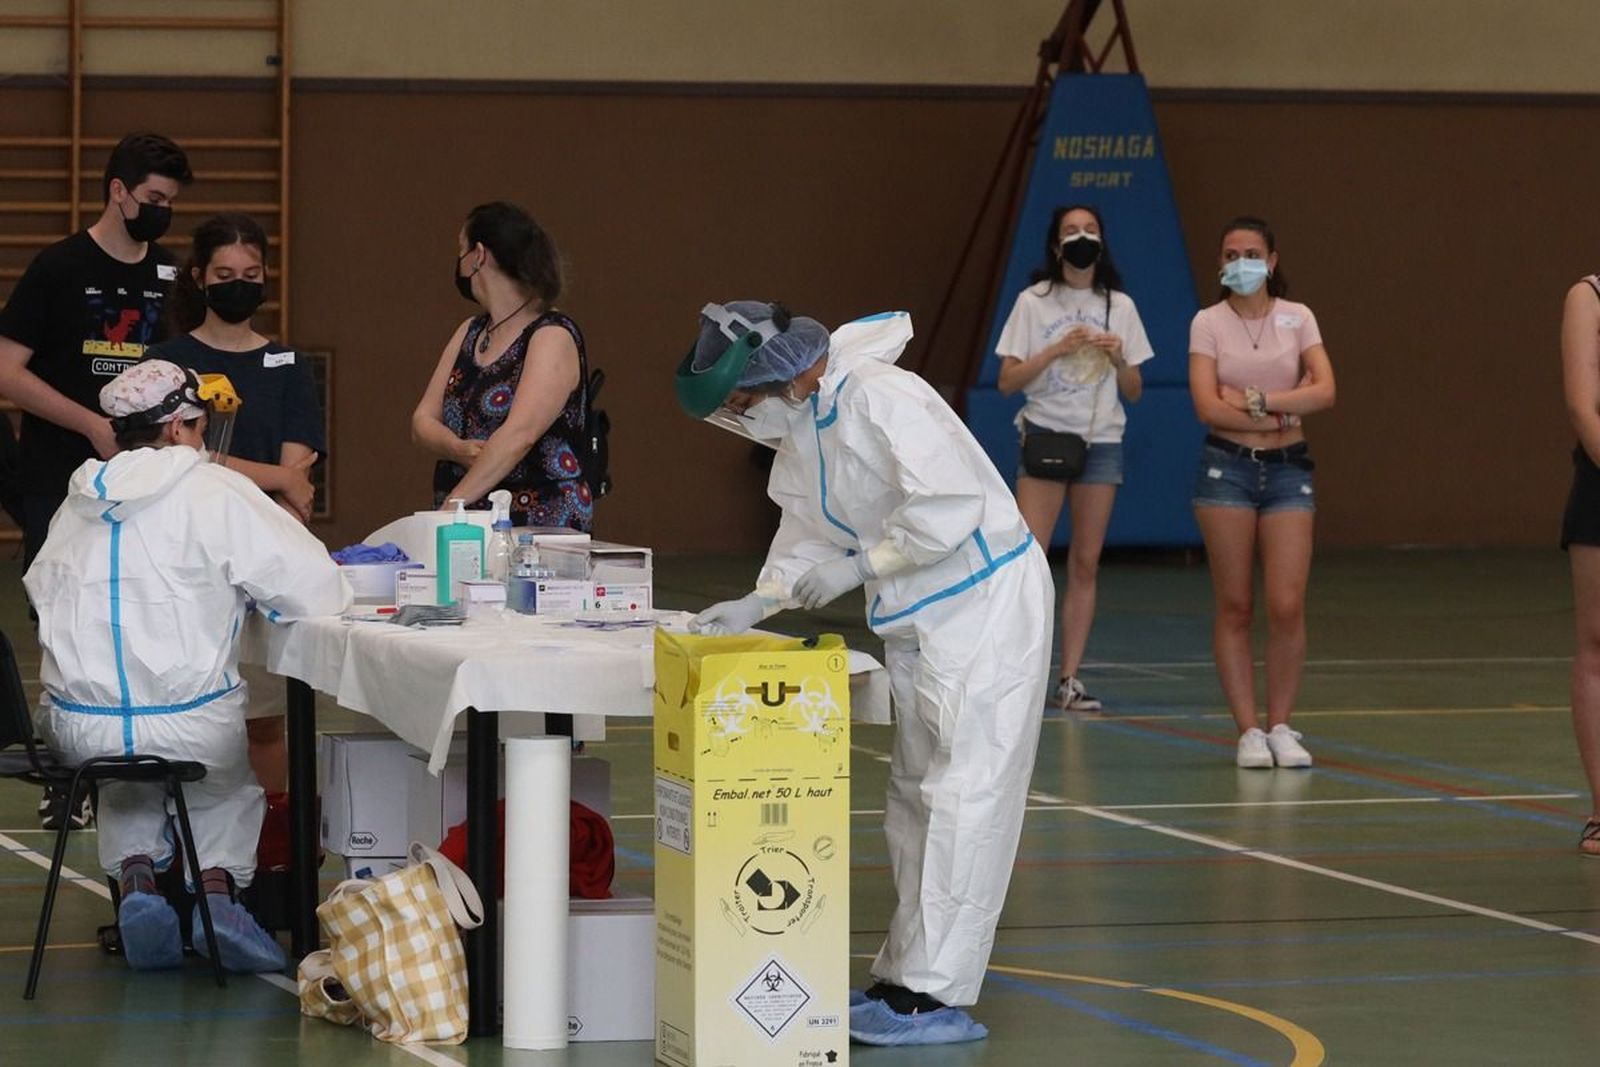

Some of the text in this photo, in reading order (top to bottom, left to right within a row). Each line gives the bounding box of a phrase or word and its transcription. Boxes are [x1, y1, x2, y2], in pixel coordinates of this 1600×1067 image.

[1053, 134, 1155, 160] NOSHAGA
[1070, 171, 1133, 188] SPORT
[776, 787, 792, 798] 50
[795, 787, 802, 798] L
[806, 786, 833, 797] haut
[351, 836, 373, 844] Roche
[760, 846, 784, 854] Trier
[733, 890, 750, 924] Traiter
[787, 877, 815, 927] Transporter
